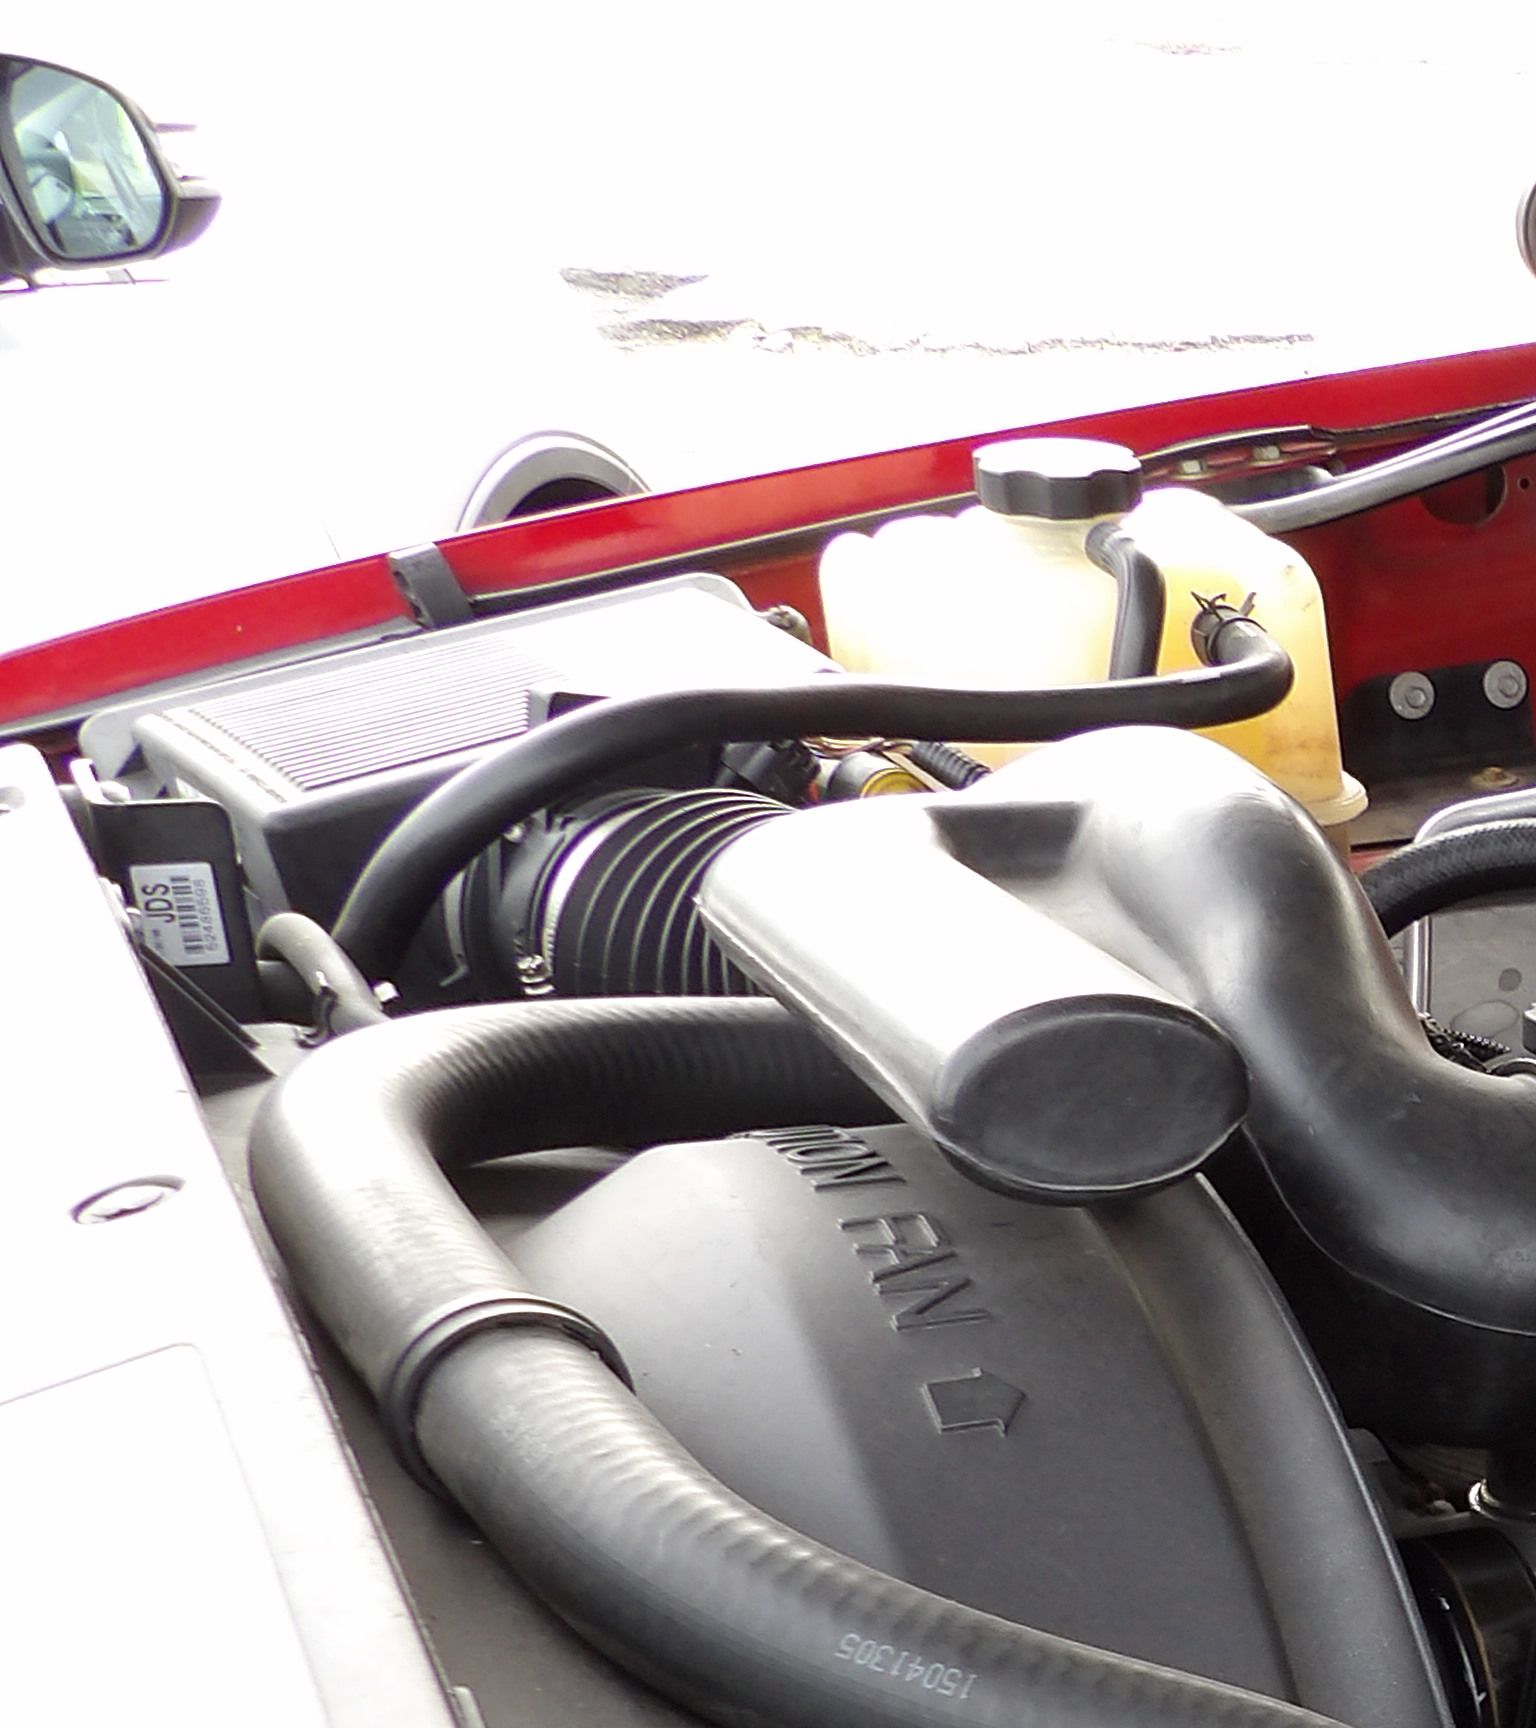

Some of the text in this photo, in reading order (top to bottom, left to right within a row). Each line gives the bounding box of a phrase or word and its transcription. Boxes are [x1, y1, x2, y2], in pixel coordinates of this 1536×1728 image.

[141, 884, 176, 923] JDS
[835, 1210, 993, 1333] FAN
[834, 1632, 978, 1700] 15041305
